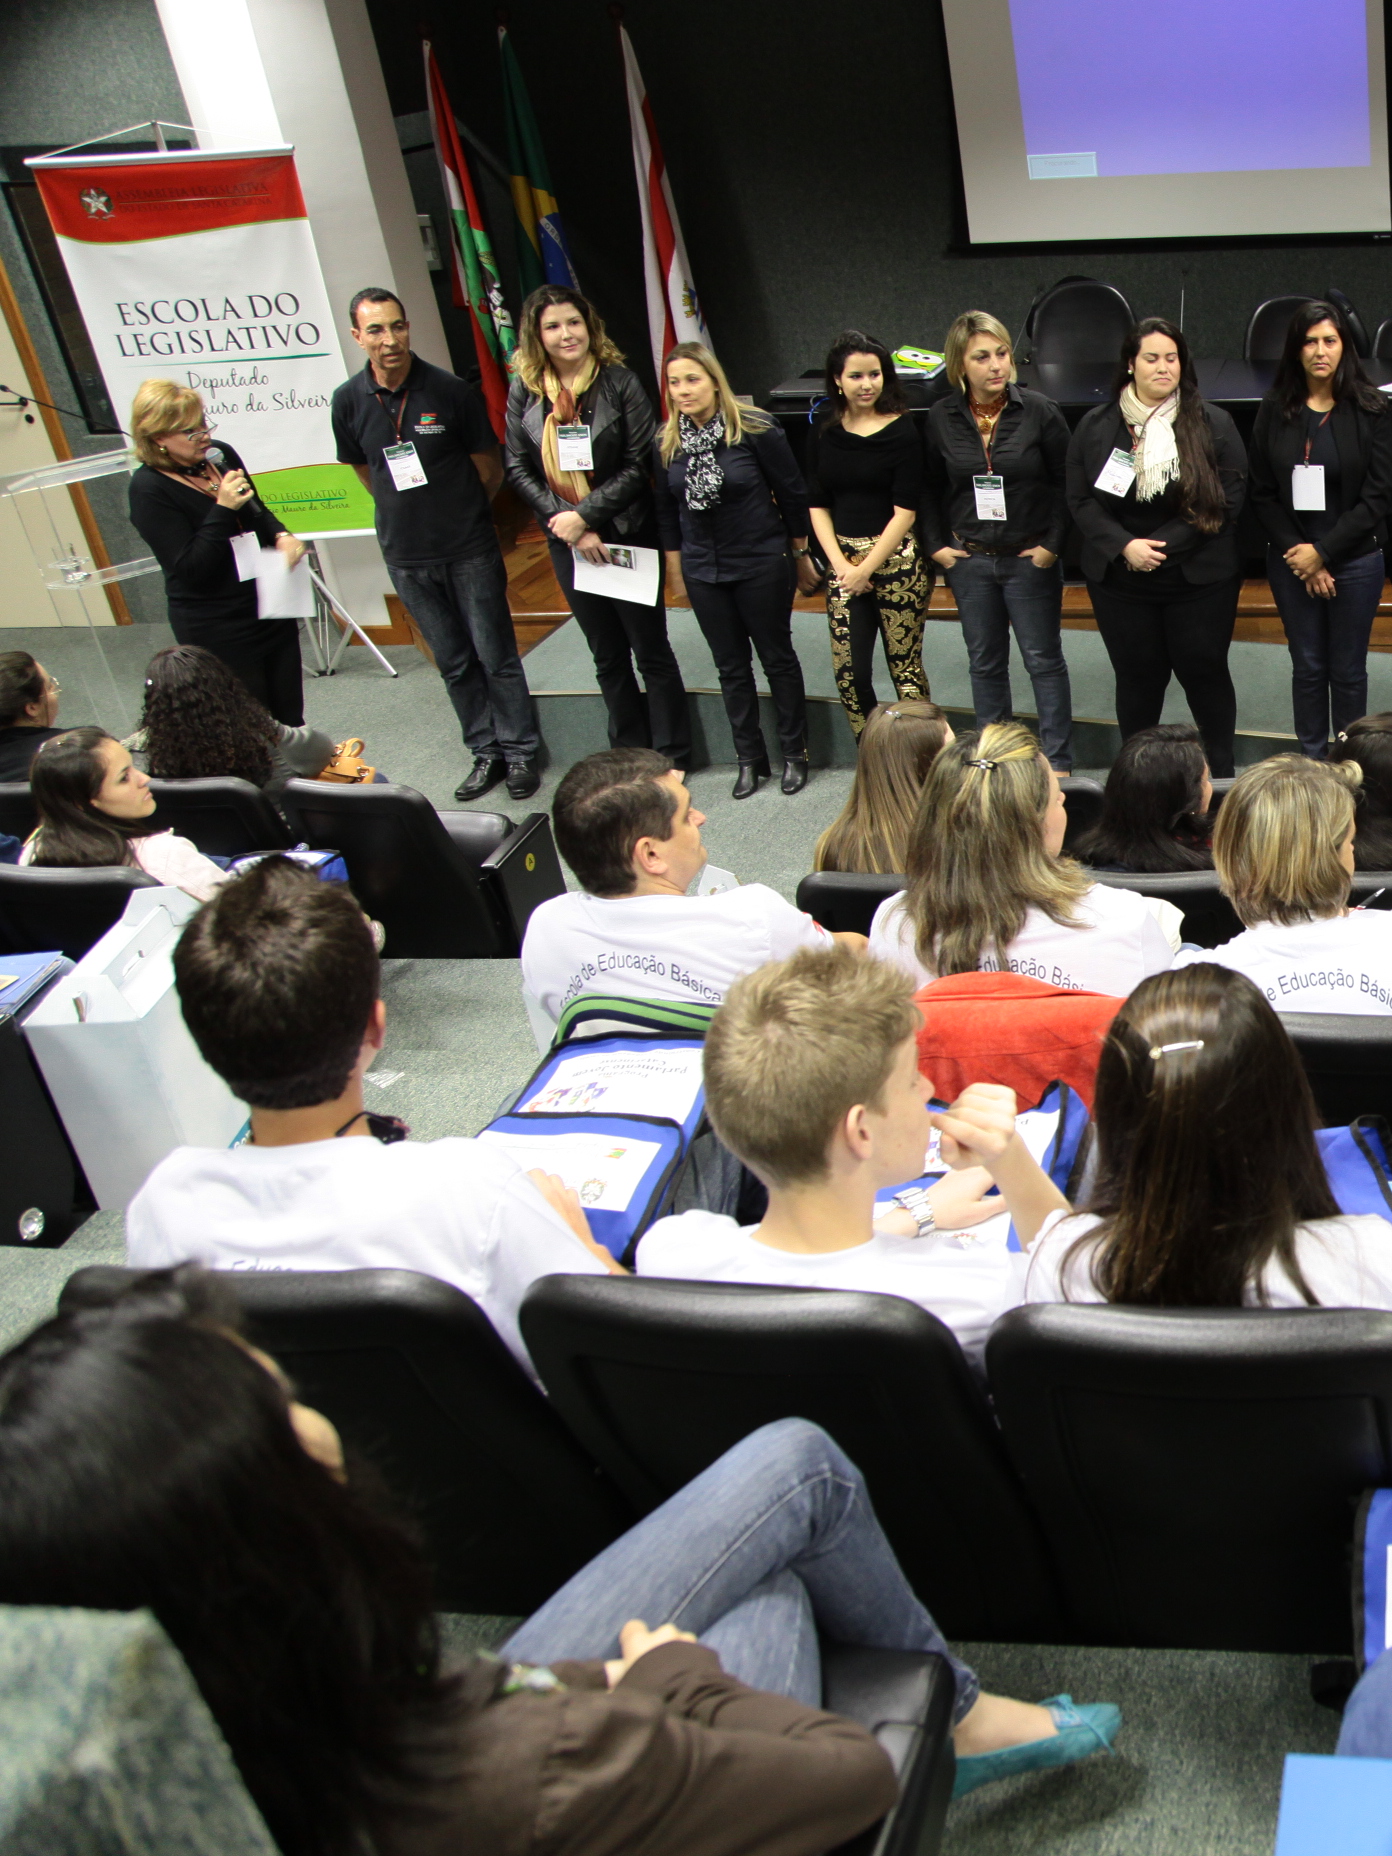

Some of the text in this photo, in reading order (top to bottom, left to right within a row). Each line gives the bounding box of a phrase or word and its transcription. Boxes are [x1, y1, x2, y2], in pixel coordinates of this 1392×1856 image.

[115, 293, 300, 326] ESCOLA DO
[114, 322, 321, 357] LEGISLATIVO
[186, 366, 269, 399] Deputado
[203, 389, 333, 415] auro da Silveir
[280, 488, 347, 501] LEGISLATIVO
[309, 502, 318, 511] da
[321, 500, 350, 510] Silveira
[581, 962, 596, 981] de
[597, 952, 666, 976] Educação
[671, 963, 722, 1001] Básica
[1266, 987, 1277, 1001] e
[1278, 968, 1354, 994] Educação
